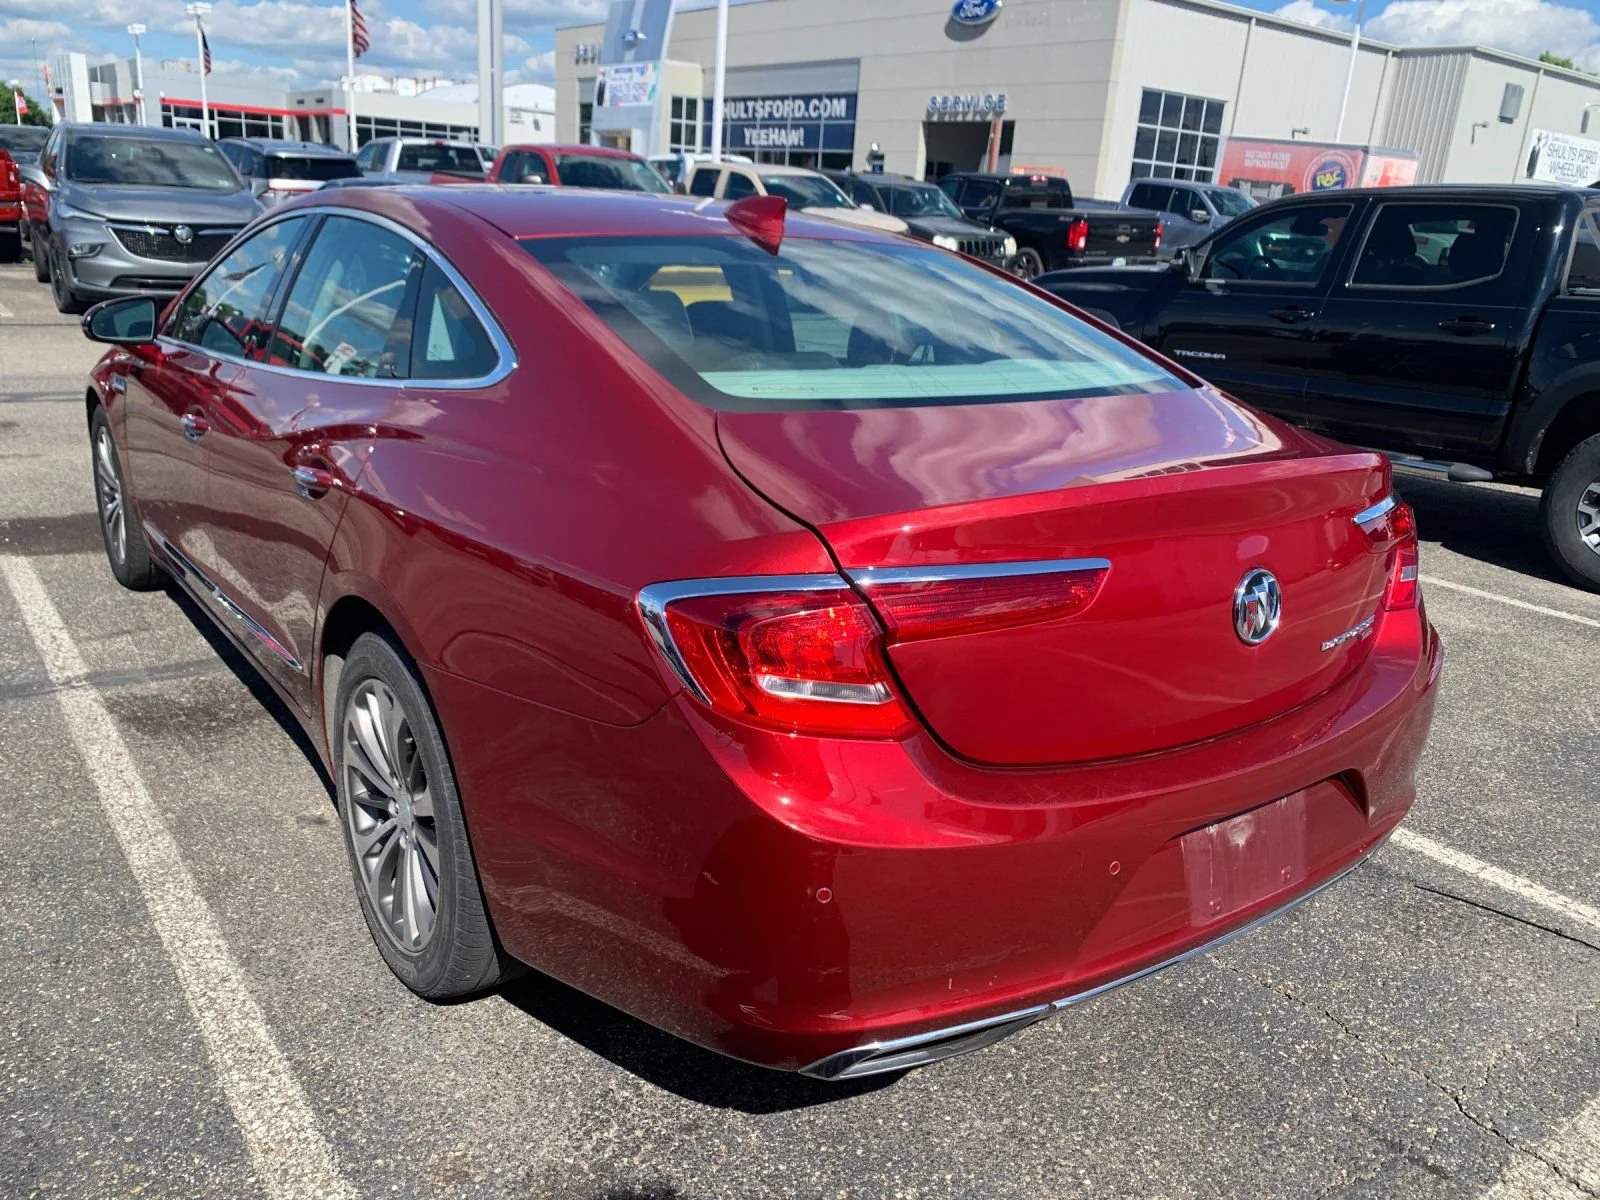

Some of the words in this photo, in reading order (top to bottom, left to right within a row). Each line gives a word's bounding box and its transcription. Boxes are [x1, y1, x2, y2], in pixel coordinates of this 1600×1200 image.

[959, 0, 988, 18] Ford
[722, 97, 847, 119] HULTSFORD.COM
[928, 93, 1008, 113] SERVICE
[1547, 142, 1578, 161] SHULTS
[1578, 148, 1598, 165] FORD
[1549, 160, 1589, 179] WHEELING
[1173, 349, 1226, 360] TACOMA
